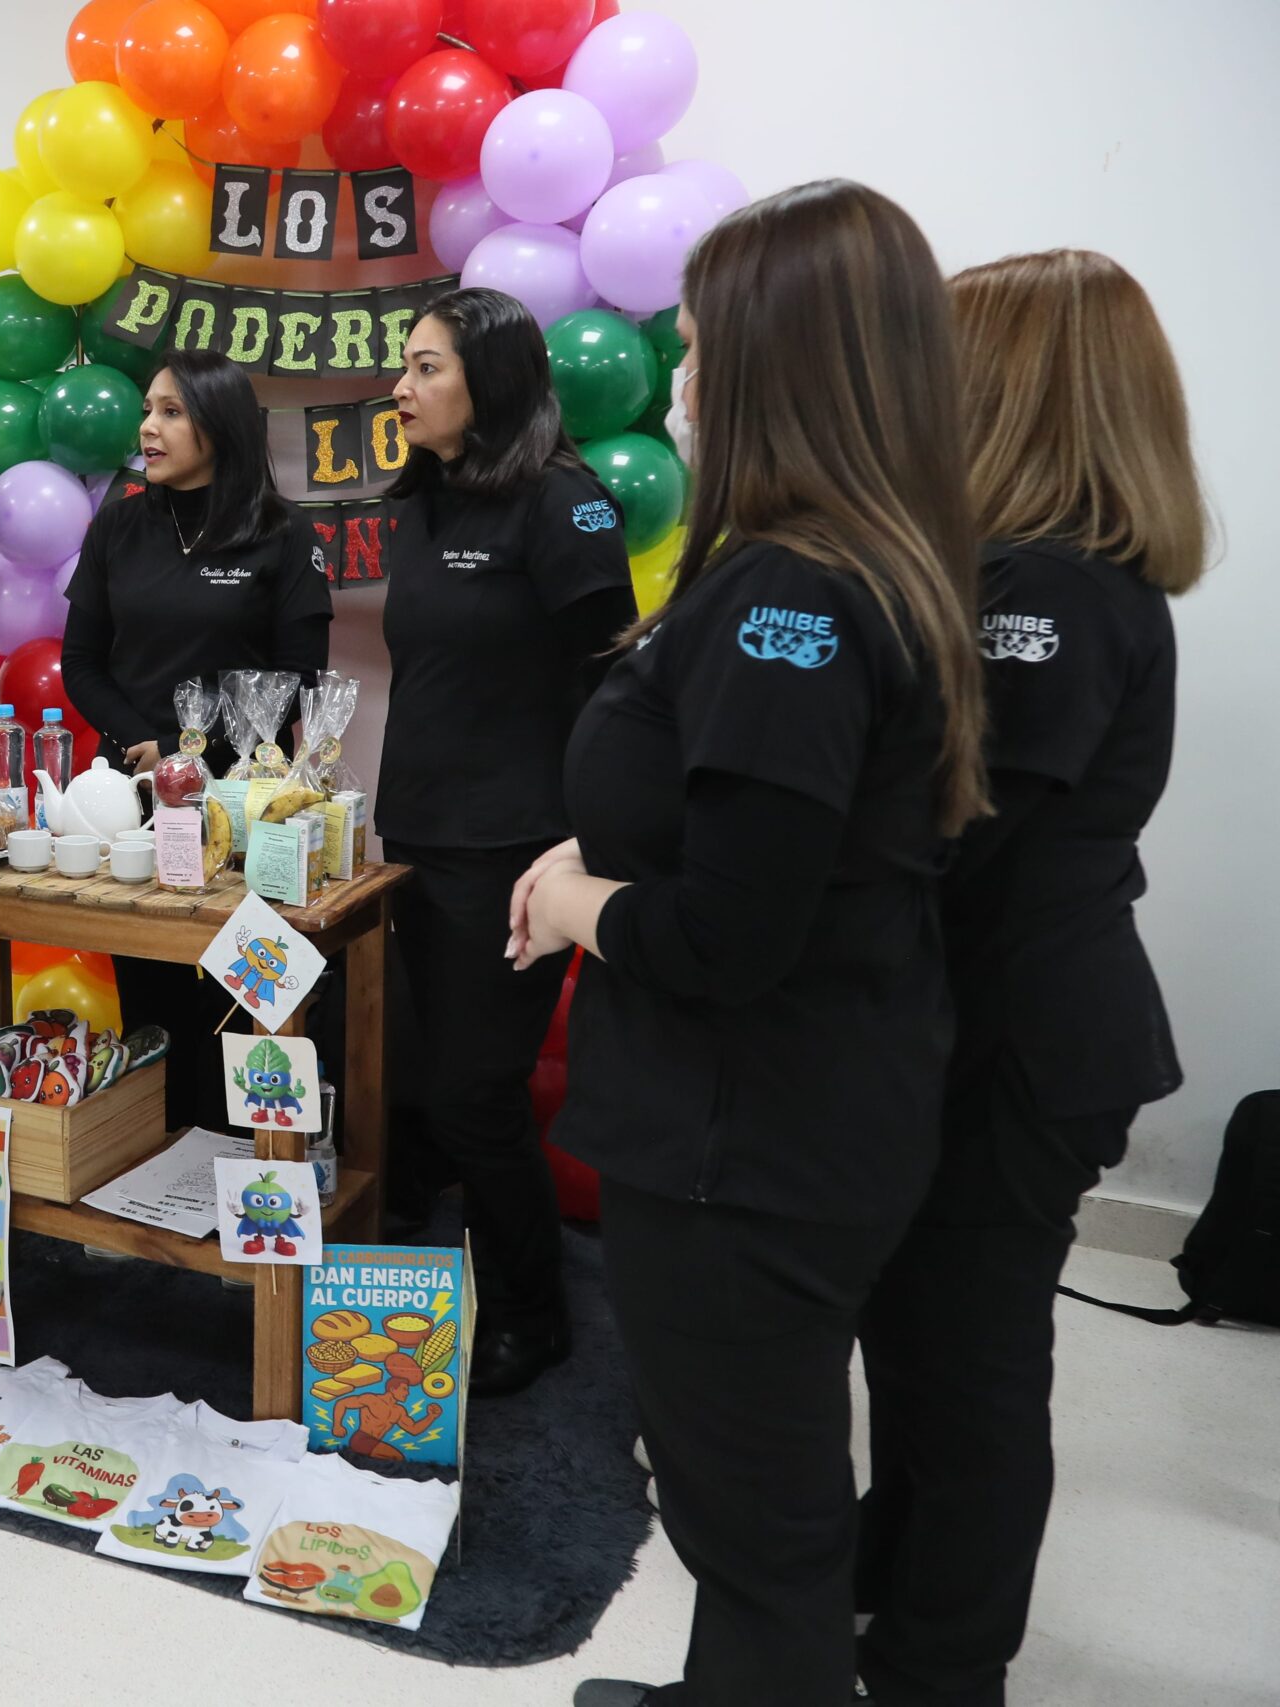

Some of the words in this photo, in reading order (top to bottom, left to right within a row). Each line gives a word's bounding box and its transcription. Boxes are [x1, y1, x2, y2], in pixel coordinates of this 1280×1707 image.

[218, 181, 408, 254] LOS
[115, 279, 416, 371] PODERE
[312, 409, 410, 484] LO
[572, 499, 610, 516] UNIBE
[749, 606, 835, 637] UNIBE
[982, 613, 1055, 635] UNIBE
[338, 1251, 454, 1268] CARBOHIDRATOS
[310, 1266, 355, 1285] DAN
[360, 1267, 454, 1290] ENERGÍA
[310, 1287, 337, 1306] AL
[342, 1287, 429, 1310] CUERPO
[71, 1443, 106, 1462] LAS
[51, 1454, 138, 1489] VITAMINAS
[304, 1522, 343, 1539] LOS
[299, 1535, 373, 1562] LÍPIDOS
